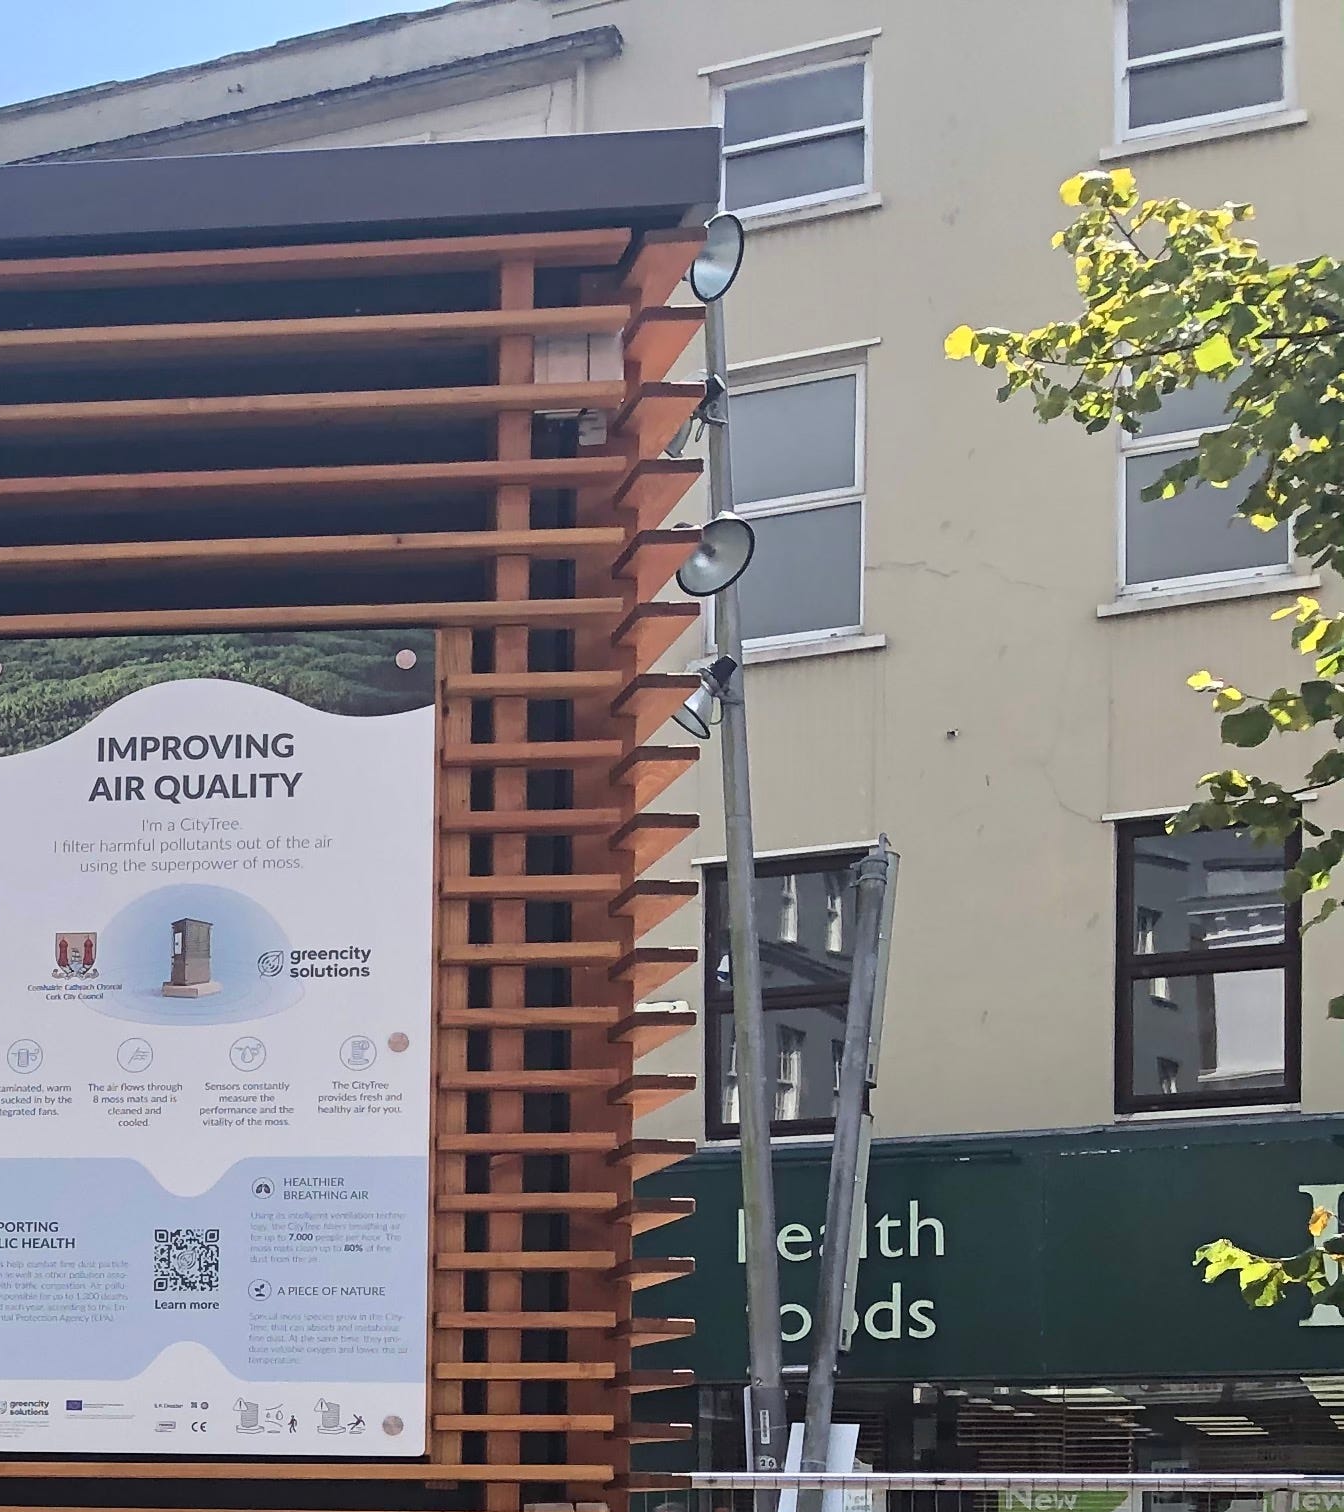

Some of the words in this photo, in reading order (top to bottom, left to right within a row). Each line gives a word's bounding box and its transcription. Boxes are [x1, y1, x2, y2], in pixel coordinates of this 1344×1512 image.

[97, 733, 294, 762] IMPROVING
[88, 776, 146, 802] AIR
[154, 772, 303, 804] QUALITY
[142, 819, 162, 832] I'm
[167, 822, 175, 832] a
[180, 817, 243, 833] CityTree.
[62, 838, 95, 853] filter
[100, 838, 156, 853] harmful
[160, 837, 232, 854] pollutants
[236, 837, 262, 852] out
[266, 836, 283, 850] of
[286, 836, 310, 850] the
[314, 835, 333, 850] air
[80, 858, 118, 874] using
[123, 858, 146, 872] the
[150, 857, 239, 873] superpower
[243, 856, 259, 870] of
[262, 857, 304, 870] moss.
[289, 945, 372, 962] greencity
[289, 961, 371, 978] solutions
[88, 1083, 104, 1092] The
[120, 1083, 145, 1092] flows
[147, 1082, 183, 1093] through
[205, 1082, 241, 1091] Sensors
[242, 1082, 290, 1092] constantly
[332, 1081, 349, 1090] The
[351, 1081, 390, 1091] CityTree
[0, 1096, 32, 1104] sucked
[33, 1096, 43, 1104] in
[44, 1096, 55, 1105] by
[58, 1096, 73, 1104] the
[101, 1096, 125, 1104] moss
[126, 1095, 148, 1103] mats
[150, 1095, 168, 1103] and
[219, 1095, 258, 1103] measure
[260, 1094, 275, 1103] the
[318, 1093, 358, 1103] provides
[359, 1093, 383, 1102] fresh
[385, 1093, 403, 1102] and
[107, 1107, 143, 1115] cleaned
[144, 1106, 162, 1115] and
[199, 1106, 258, 1116] performance
[259, 1105, 277, 1114] and
[278, 1105, 295, 1114] the
[317, 1105, 352, 1115] healthy
[353, 1105, 366, 1113] air
[367, 1105, 381, 1113] for
[202, 1118, 233, 1128] vitality
[235, 1117, 245, 1126] of
[247, 1117, 262, 1126] the
[283, 1177, 345, 1187] HEALTHIER
[283, 1190, 348, 1200] BREATHING
[350, 1190, 369, 1200] AIR
[21, 1238, 76, 1249] HEALTH
[277, 1286, 286, 1296] A
[288, 1286, 319, 1297] PIECE
[321, 1286, 337, 1297] OF
[340, 1286, 386, 1297] NATURE
[154, 1299, 187, 1310] Learn
[189, 1301, 220, 1310] more
